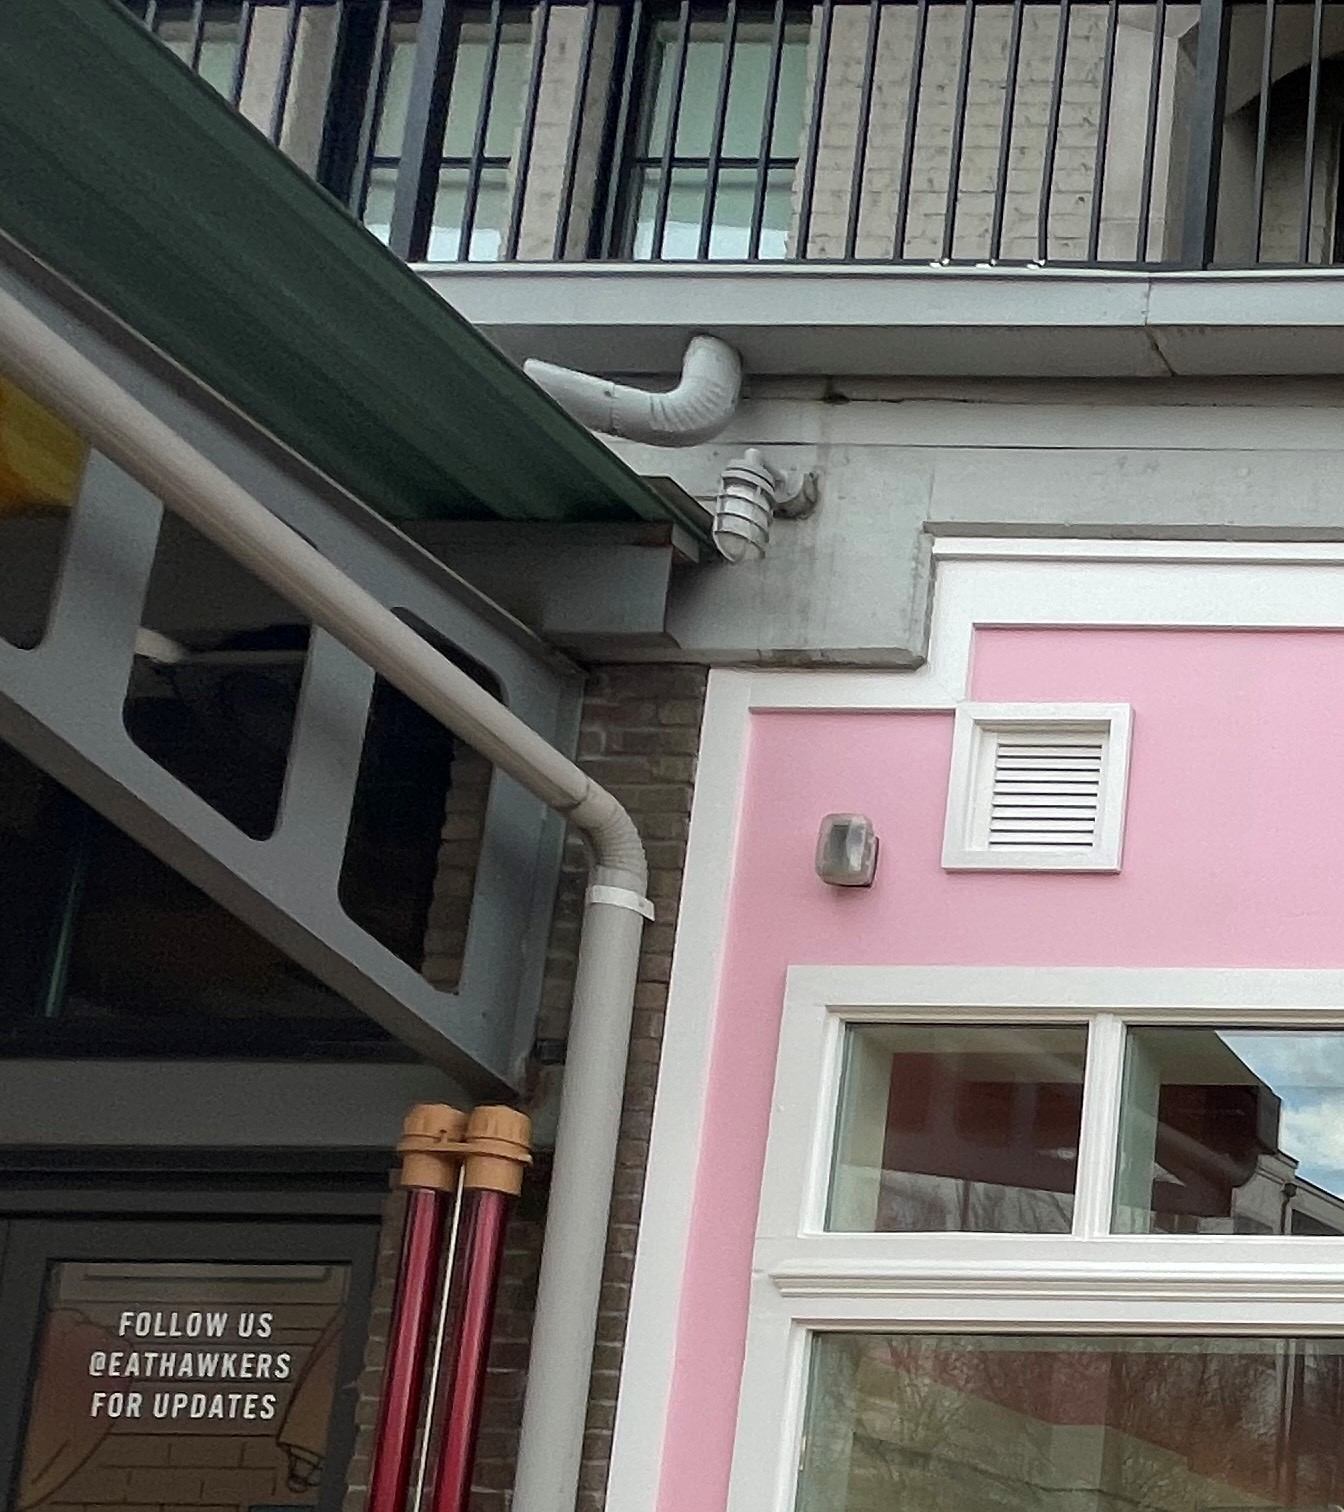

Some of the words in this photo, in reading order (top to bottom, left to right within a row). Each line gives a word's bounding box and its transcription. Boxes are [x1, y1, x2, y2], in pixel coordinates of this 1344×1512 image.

[118, 1312, 228, 1337] FOLLOW
[238, 1313, 274, 1338] US
[88, 1352, 291, 1379] @EATHAWKERS
[90, 1393, 141, 1418] FOR
[152, 1393, 277, 1420] UPDATES
